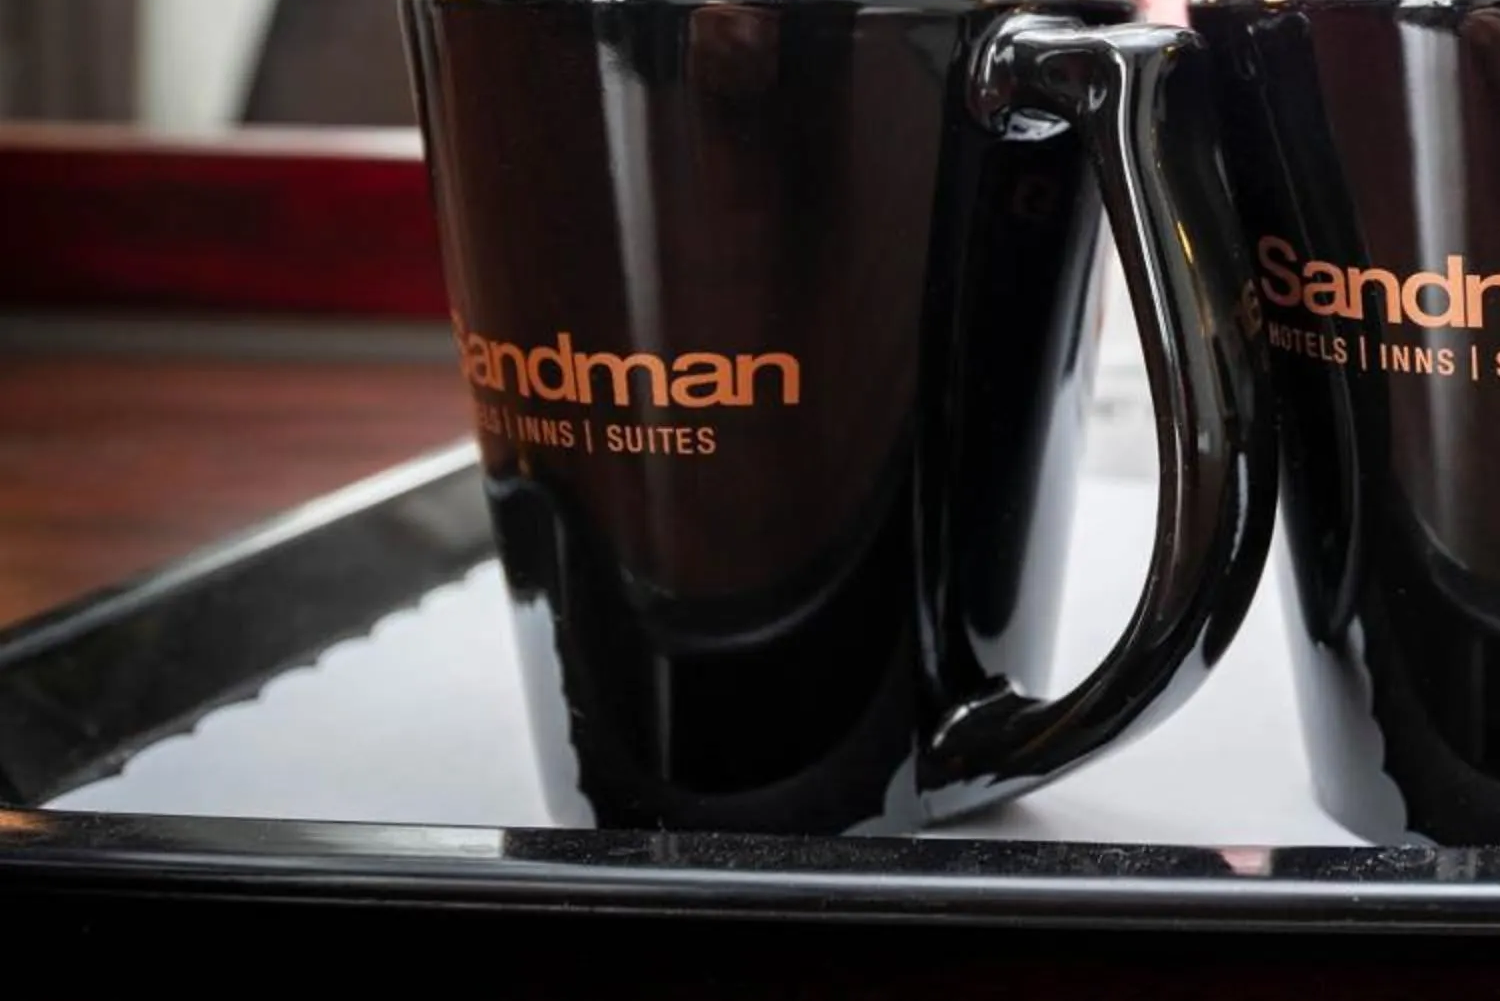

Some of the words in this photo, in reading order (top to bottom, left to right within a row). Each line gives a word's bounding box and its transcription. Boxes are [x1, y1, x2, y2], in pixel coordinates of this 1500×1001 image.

[1267, 321, 1348, 365] HOTELS
[1380, 342, 1455, 376] INNS
[517, 415, 575, 448] INNS
[606, 423, 717, 455] SUITES
